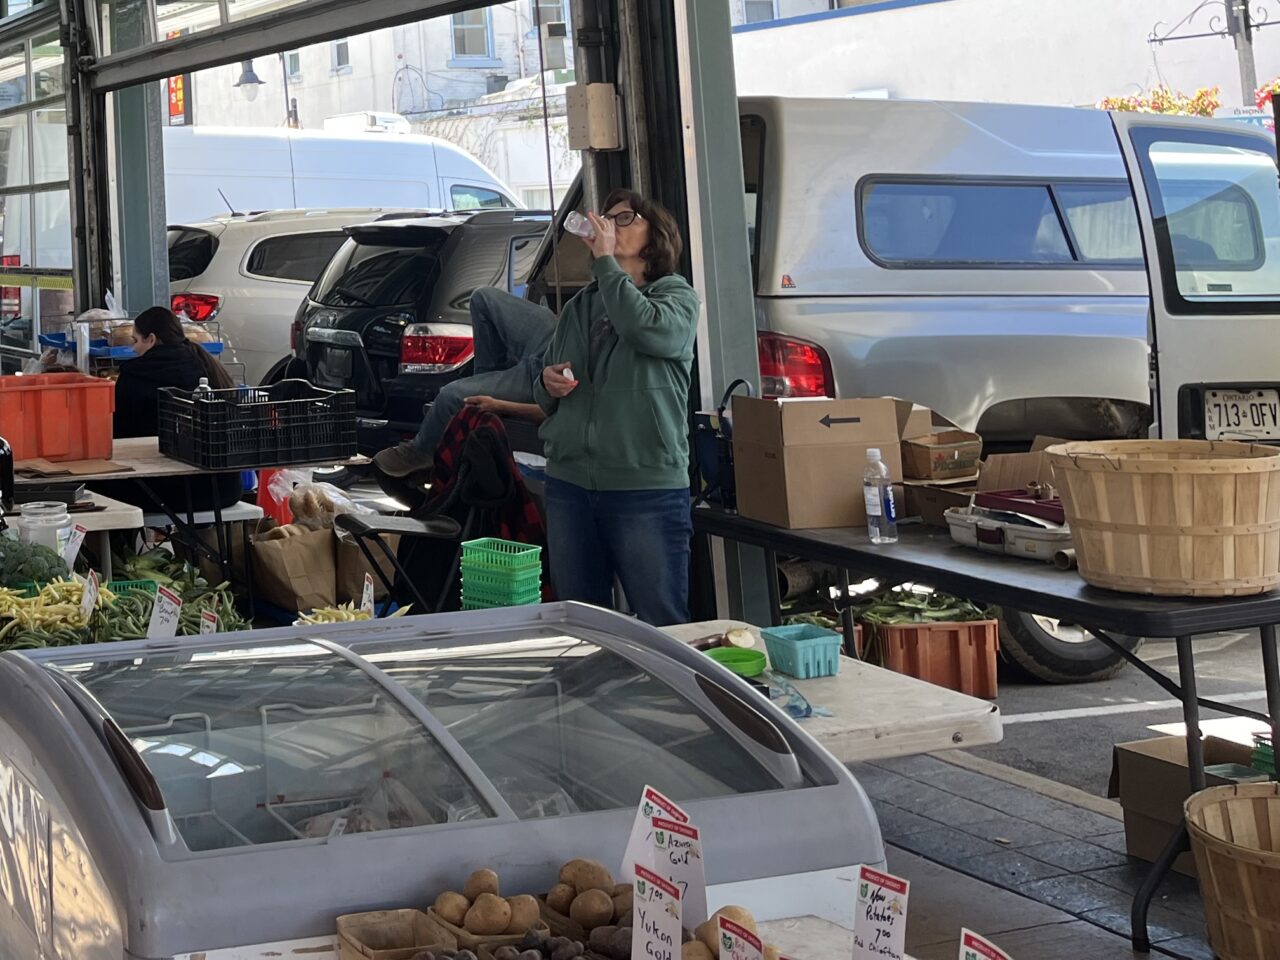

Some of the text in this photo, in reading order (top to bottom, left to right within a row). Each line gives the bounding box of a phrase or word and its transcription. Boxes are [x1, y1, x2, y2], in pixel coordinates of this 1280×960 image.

[1222, 393, 1254, 402] ONTARIO
[1214, 403, 1241, 427] 713
[870, 887, 886, 904] New
[638, 907, 672, 946] Yukon
